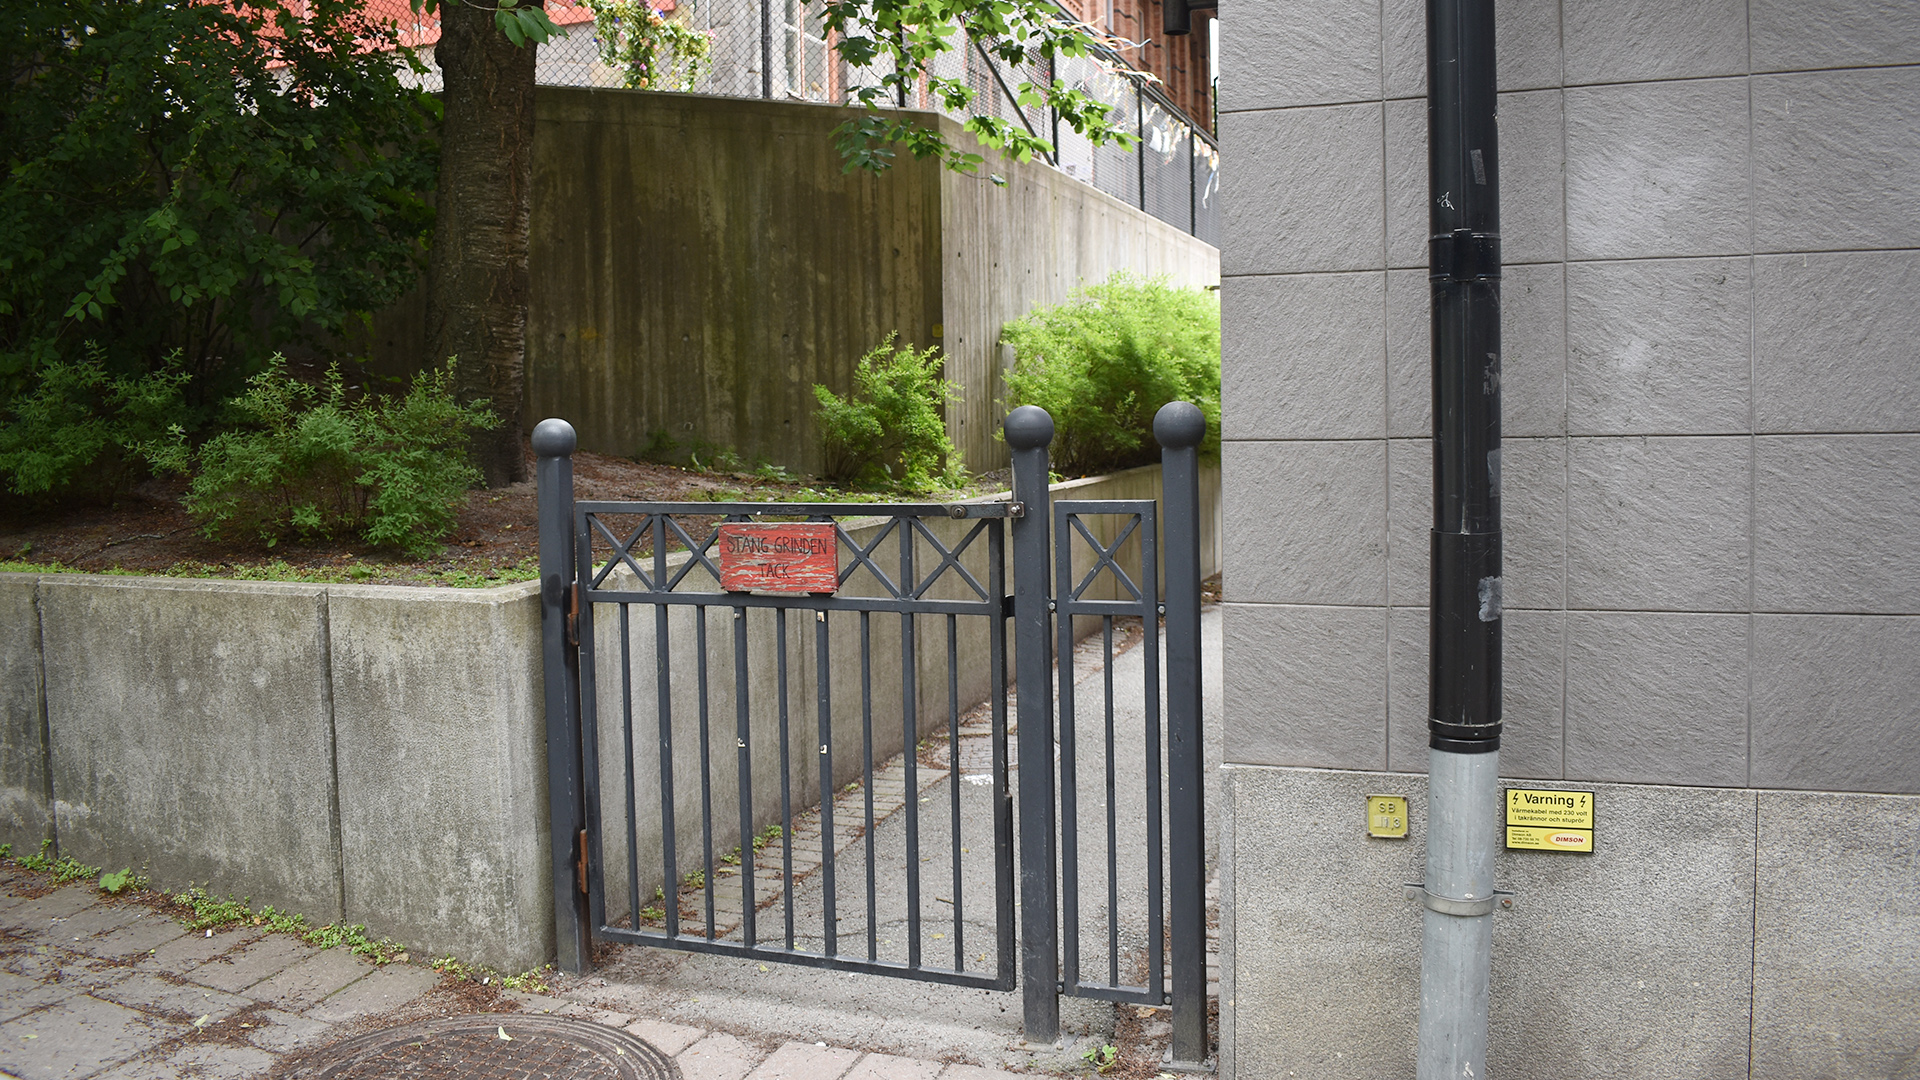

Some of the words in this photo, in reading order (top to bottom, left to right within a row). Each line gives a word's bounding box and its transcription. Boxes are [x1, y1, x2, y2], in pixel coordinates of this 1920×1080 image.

[727, 534, 769, 554] STÄNG
[774, 536, 827, 555] GRINDEN
[758, 563, 791, 579] TACK
[1379, 801, 1395, 813] SB
[1524, 793, 1574, 808] Varning
